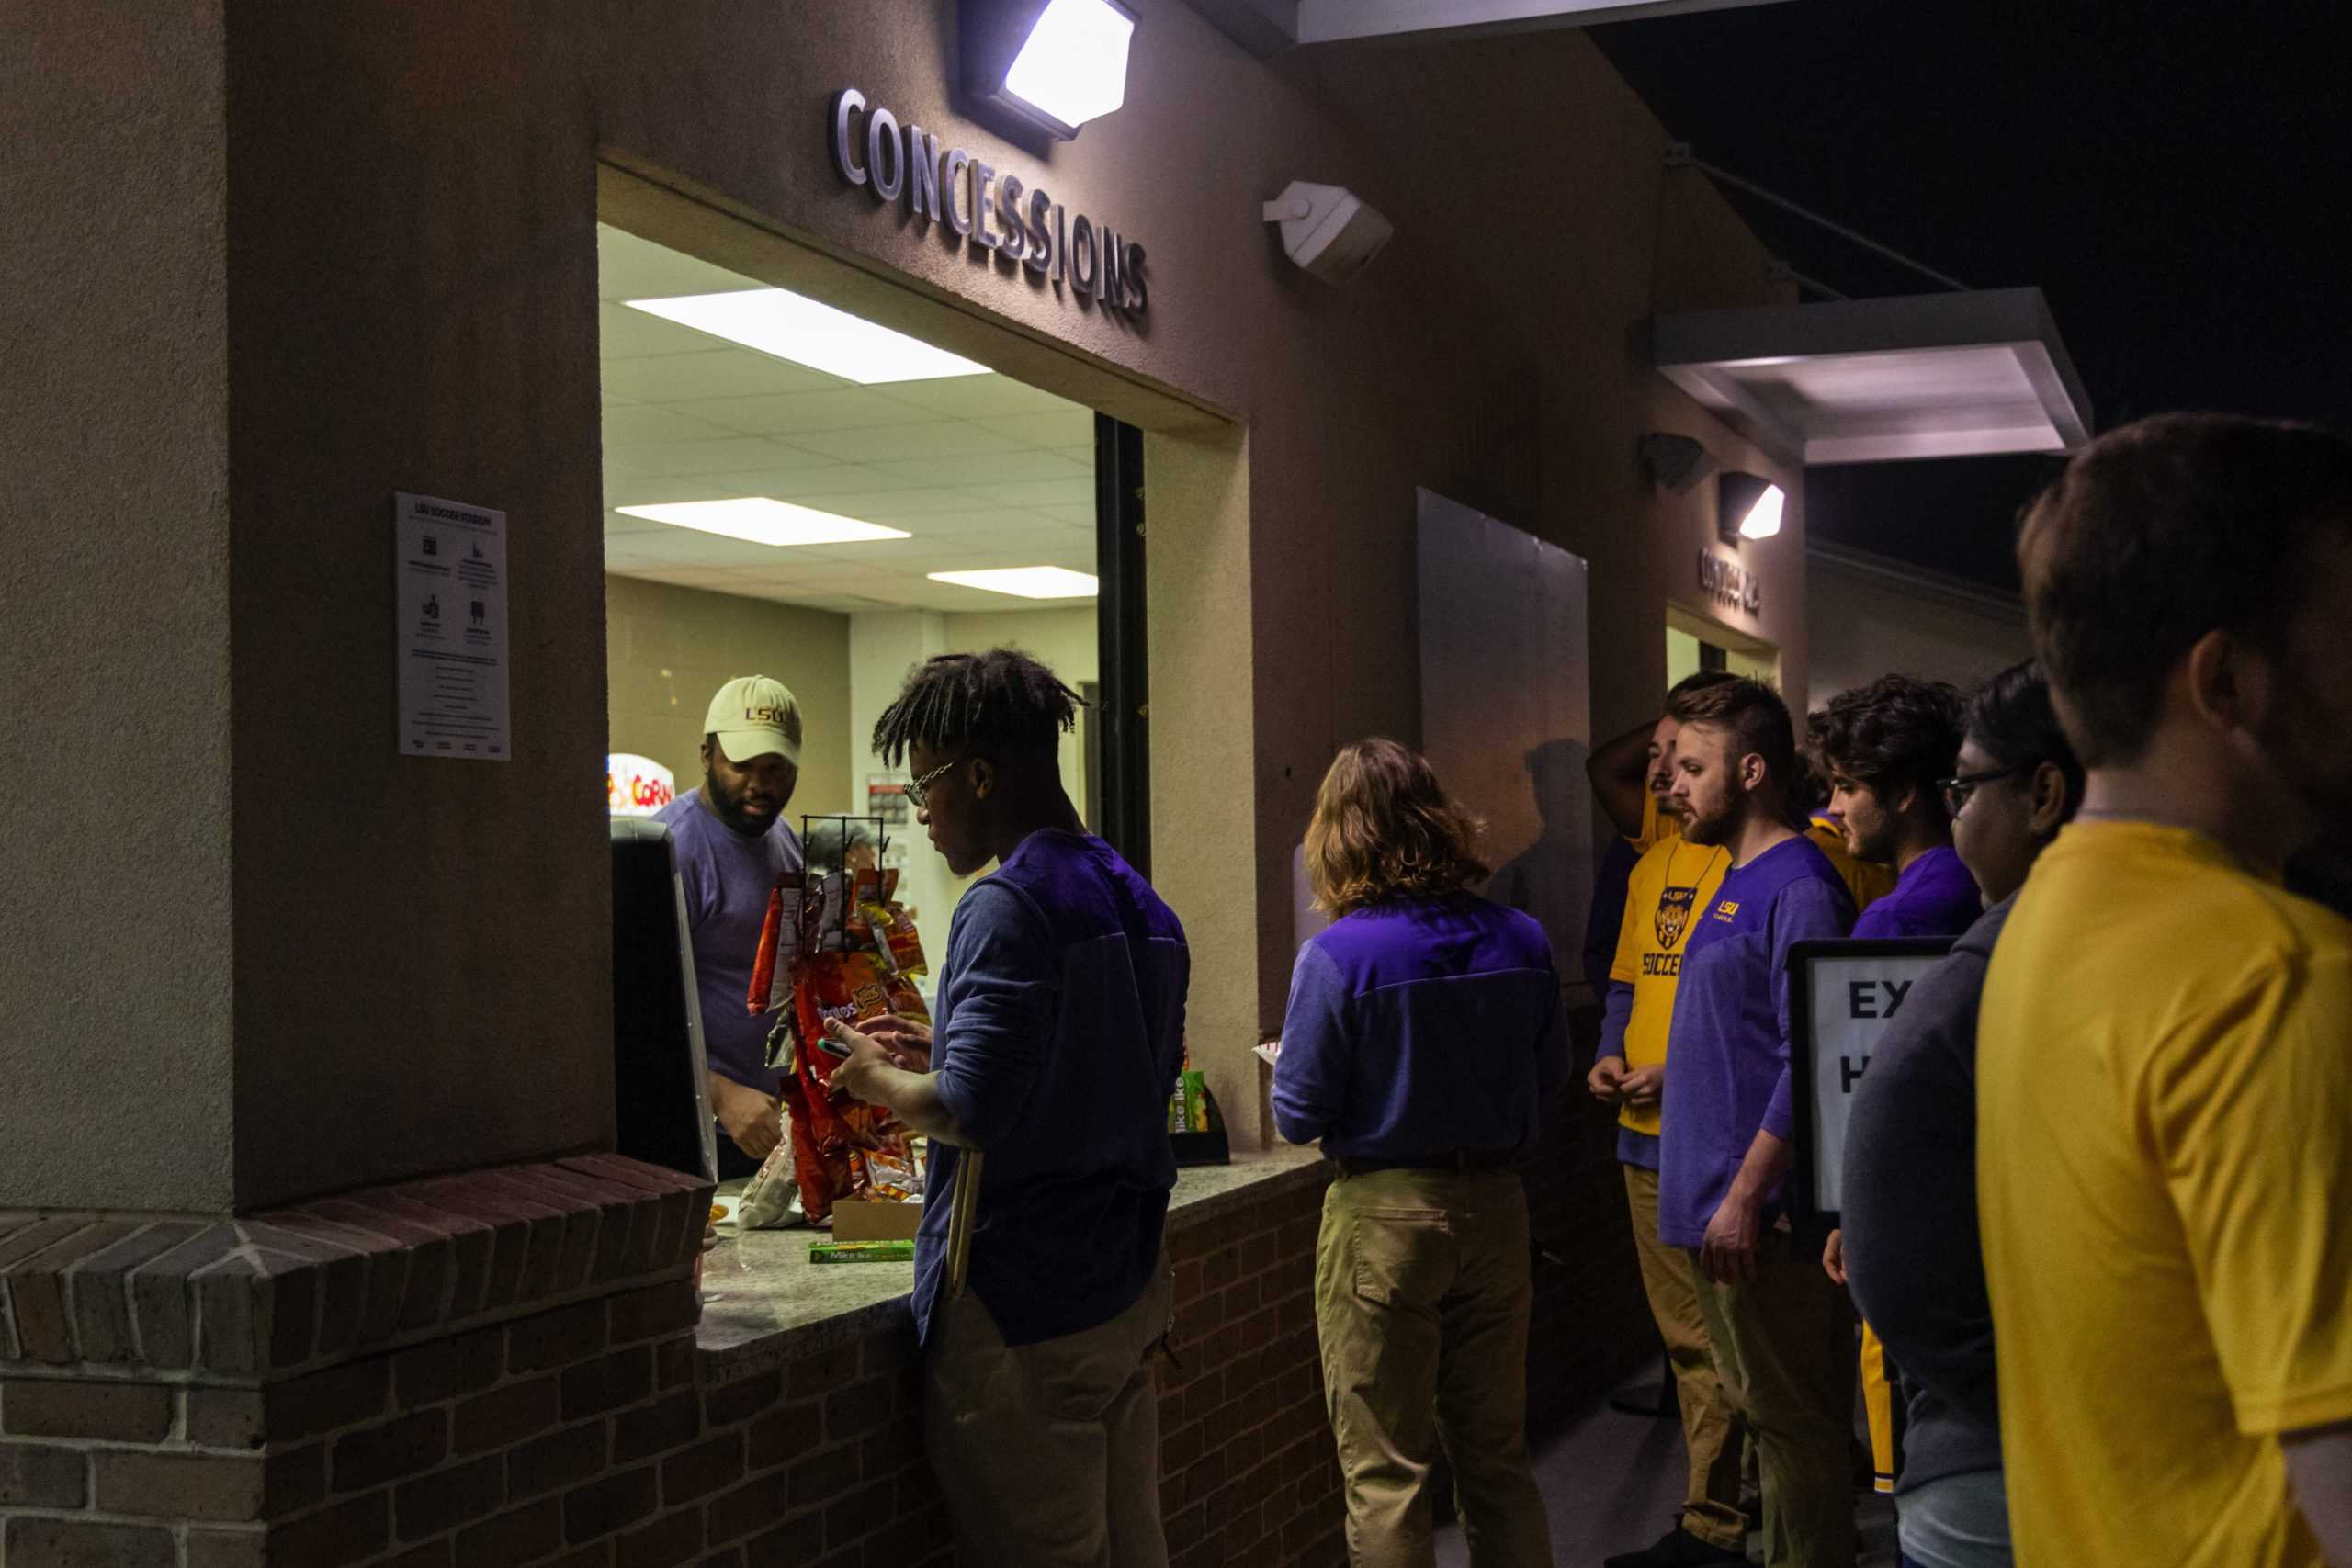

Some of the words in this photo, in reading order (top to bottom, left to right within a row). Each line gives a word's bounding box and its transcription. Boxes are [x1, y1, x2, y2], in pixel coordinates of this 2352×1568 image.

[831, 87, 1148, 318] CONCESSIONS
[745, 706, 784, 724] LSU
[1668, 890, 1689, 900] LSU
[1718, 899, 1740, 915] LSU
